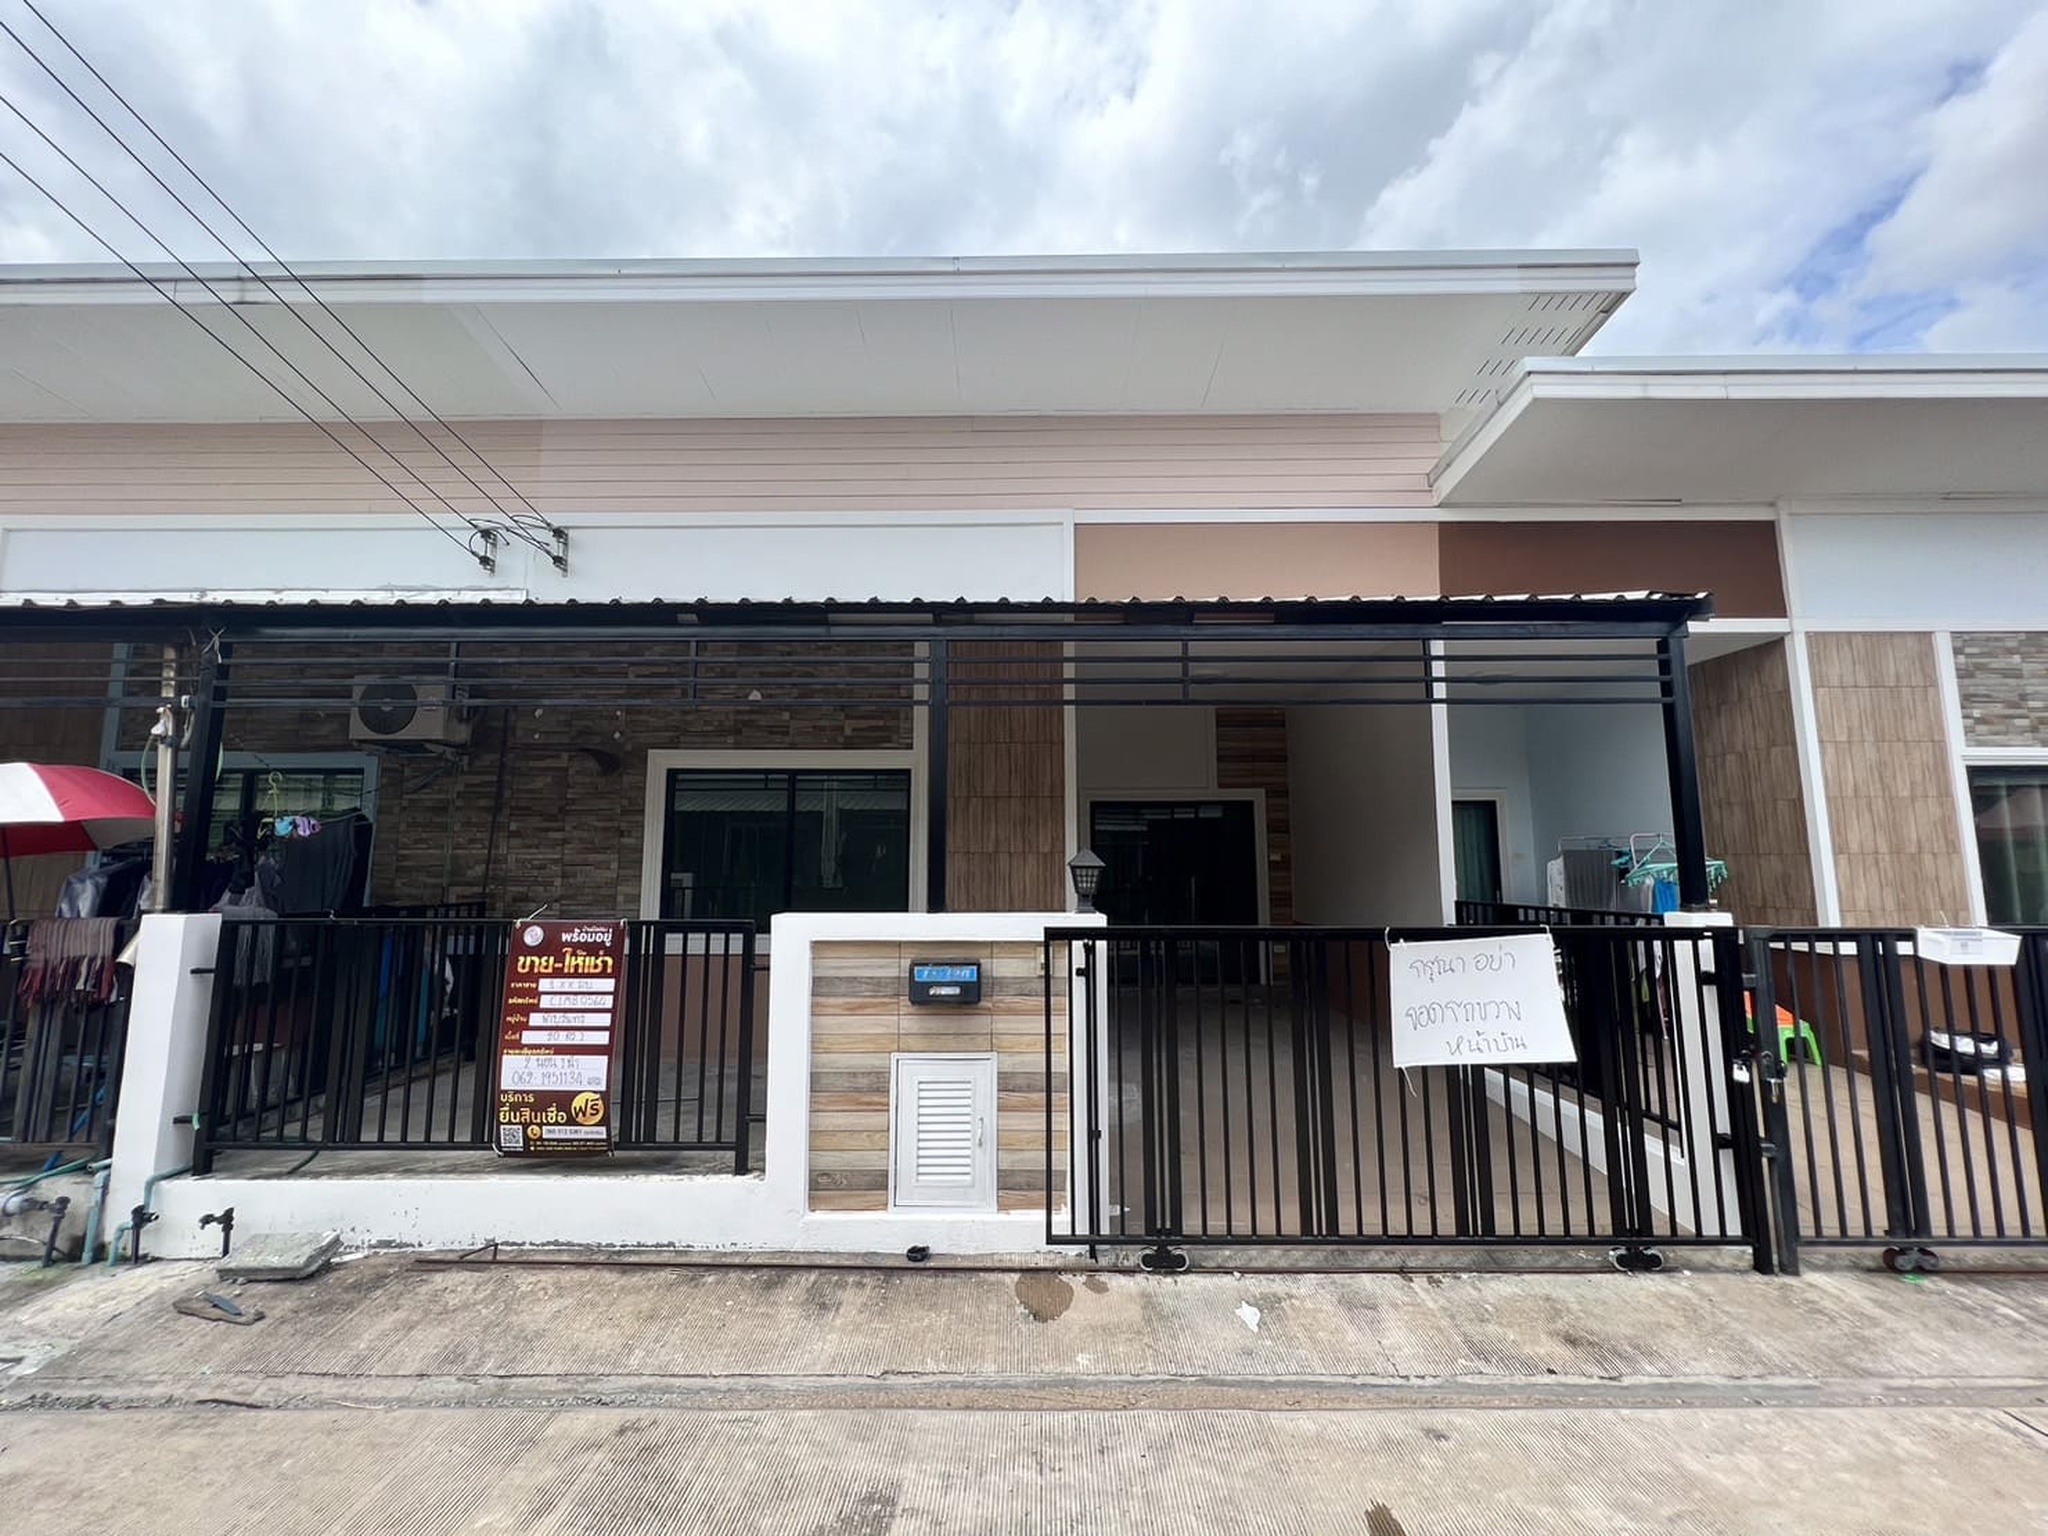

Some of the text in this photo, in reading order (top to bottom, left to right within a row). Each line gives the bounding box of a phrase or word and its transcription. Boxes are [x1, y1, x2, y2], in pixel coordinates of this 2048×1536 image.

[561, 928, 613, 947] พร้อมอยู่
[517, 947, 614, 974] ขาย-ให้เช่า
[1472, 944, 1516, 971] อย่า
[1446, 1030, 1528, 1056] หน้าบ้าน
[500, 1092, 535, 1103] บริการ
[573, 1094, 601, 1119] ฟรี
[500, 1103, 567, 1124] ยื่นสินเชื่อ
